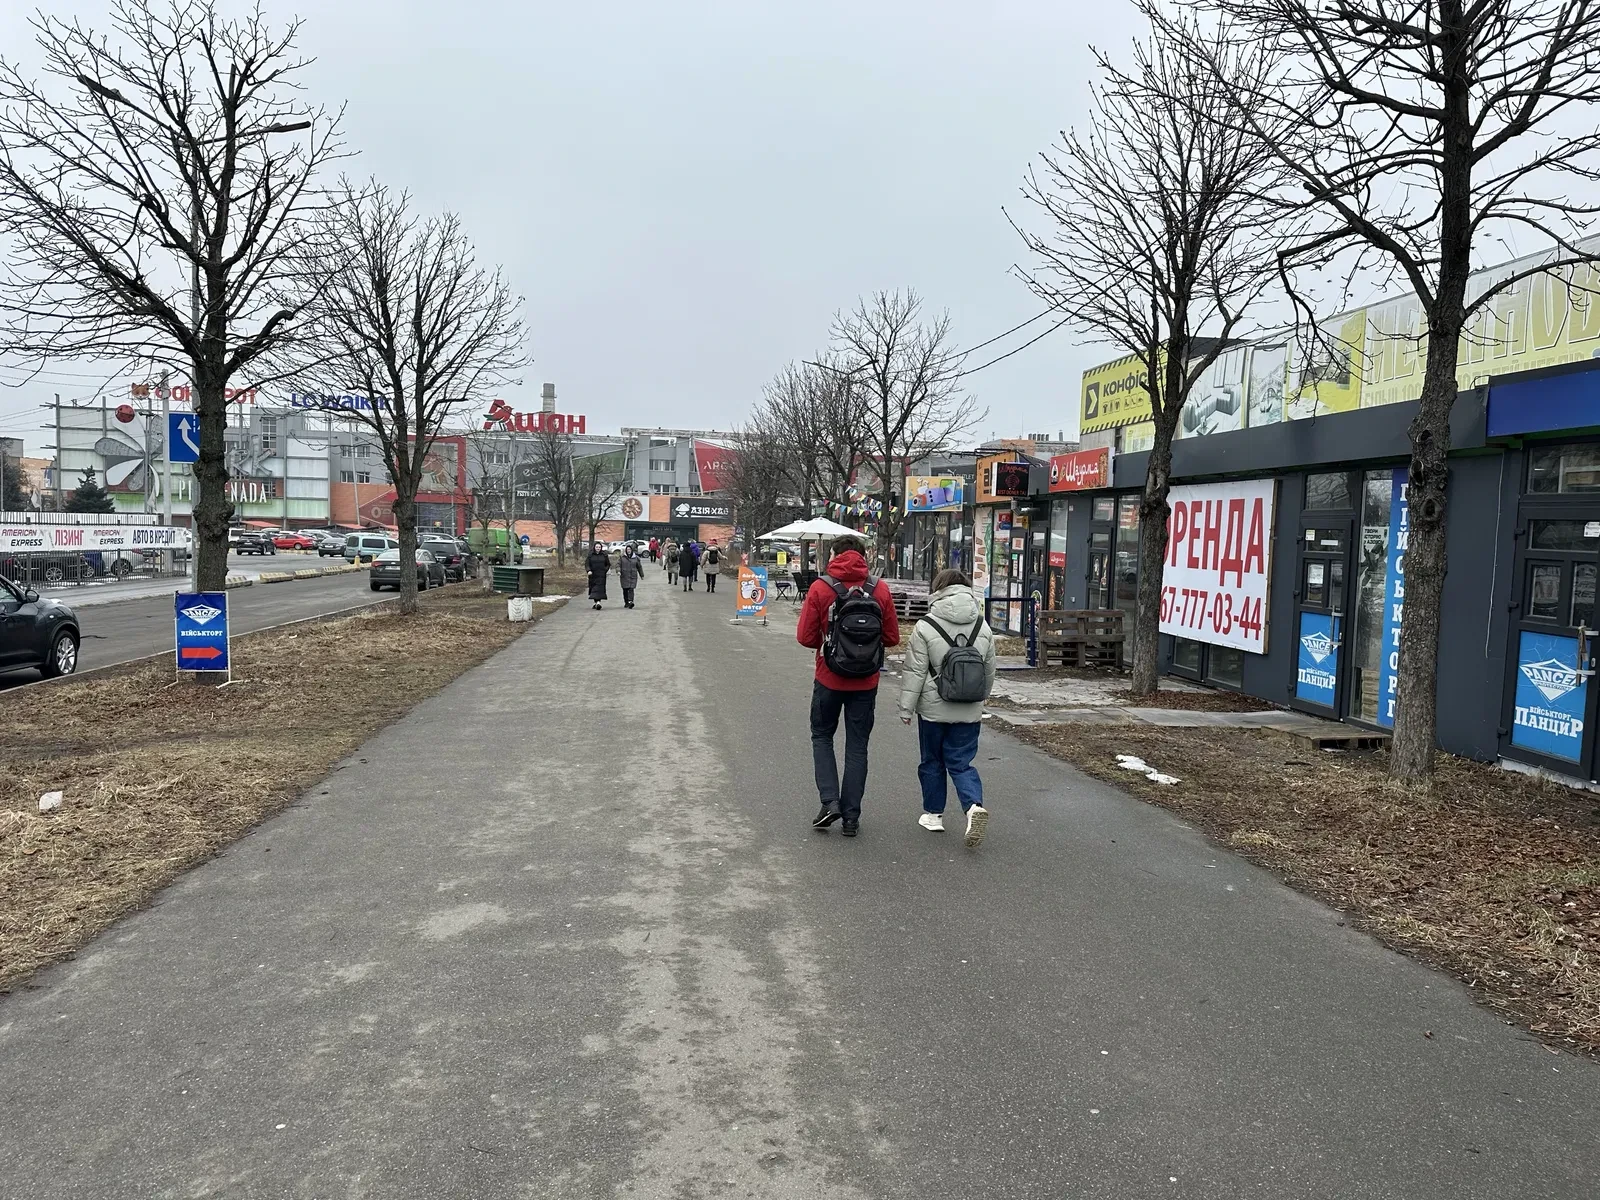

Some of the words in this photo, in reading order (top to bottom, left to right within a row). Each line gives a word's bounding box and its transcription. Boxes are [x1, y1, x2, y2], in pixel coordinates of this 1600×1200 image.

[1065, 456, 1099, 486] Шаурма
[1, 528, 37, 537] AMERICAN
[54, 529, 85, 546] ЛІЗИНГ
[93, 529, 121, 537] AMERICAN
[132, 529, 149, 544] АВТО
[149, 529, 155, 544] В
[155, 529, 176, 547] КРЕДИТ
[10, 538, 43, 547] EXPRESS
[99, 537, 124, 546] EXPRESS
[180, 629, 223, 637] ВІЙСЬКТОРГ
[1297, 668, 1336, 690] ПАНЦИР
[1529, 705, 1572, 720] ВІЙСЬКТОРГ
[1514, 706, 1584, 738] ПАНЦИР
